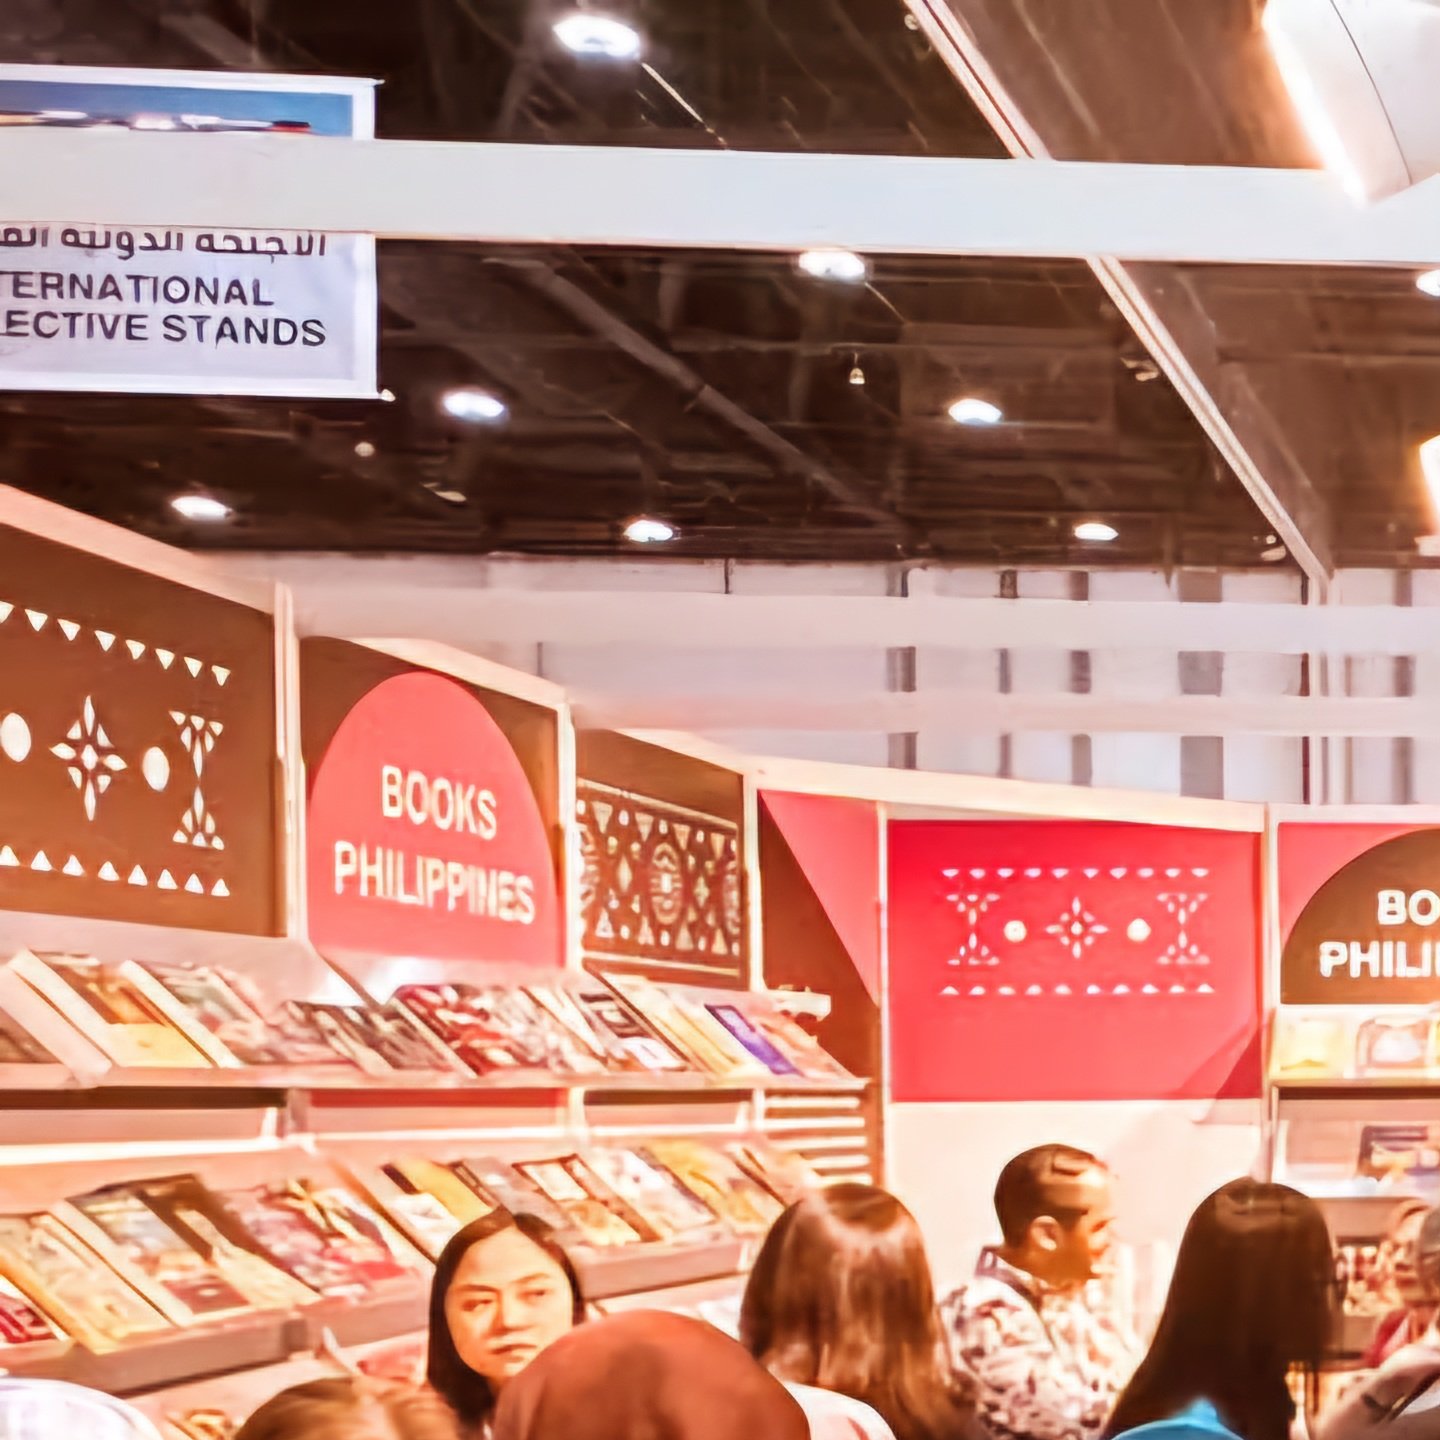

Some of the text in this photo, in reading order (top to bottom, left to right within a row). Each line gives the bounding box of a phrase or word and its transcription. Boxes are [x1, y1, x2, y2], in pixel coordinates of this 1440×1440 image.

[162, 314, 326, 347] STANDS
[381, 764, 497, 841] BOOKS
[334, 840, 536, 925] PHILIPPINES
